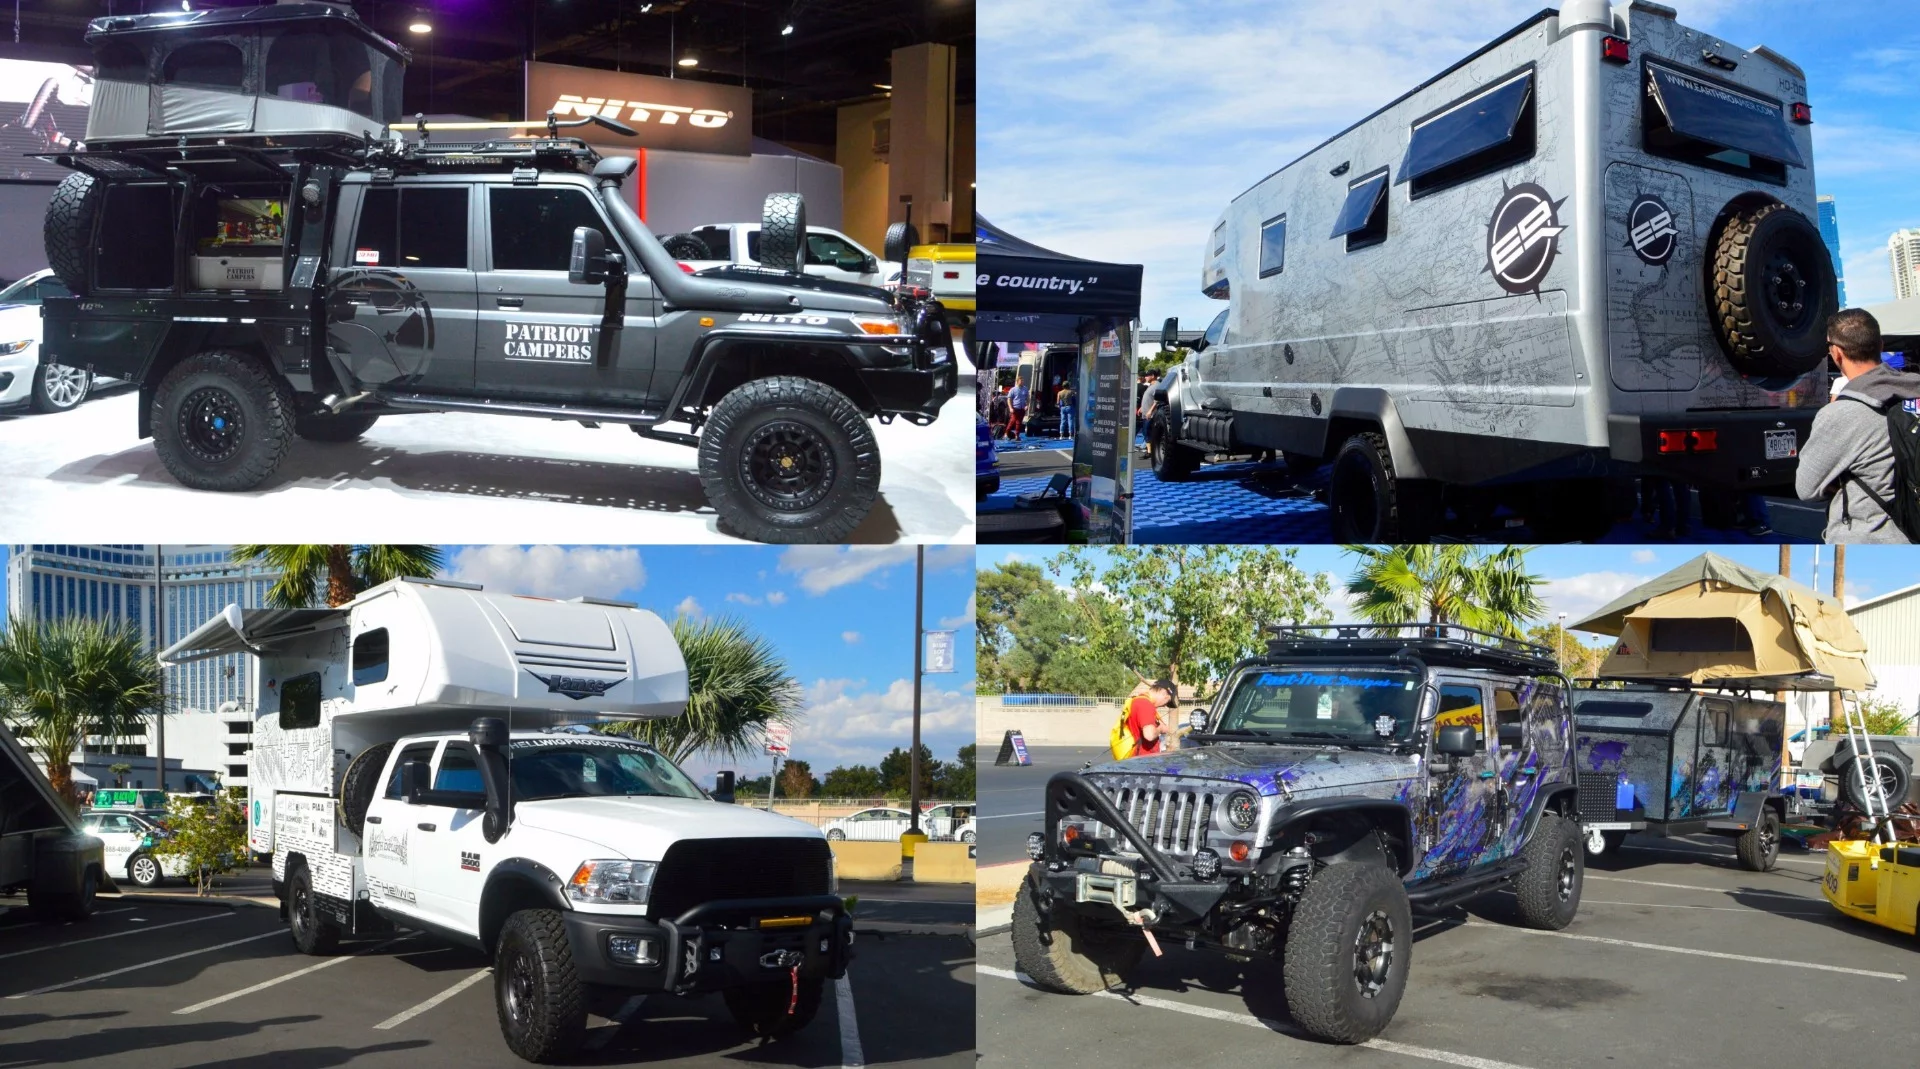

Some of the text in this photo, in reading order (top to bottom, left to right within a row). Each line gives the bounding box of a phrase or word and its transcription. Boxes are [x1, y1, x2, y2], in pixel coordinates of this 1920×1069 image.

[552, 94, 728, 128] NITTO
[737, 312, 829, 325] NITTO
[505, 323, 593, 343] PATRIOT
[503, 341, 592, 360] CAMPERS
[935, 656, 943, 667] 2
[548, 674, 606, 696] Lance
[461, 851, 480, 860] RAM
[461, 858, 480, 868] 3500
[1826, 872, 1838, 894] 409
